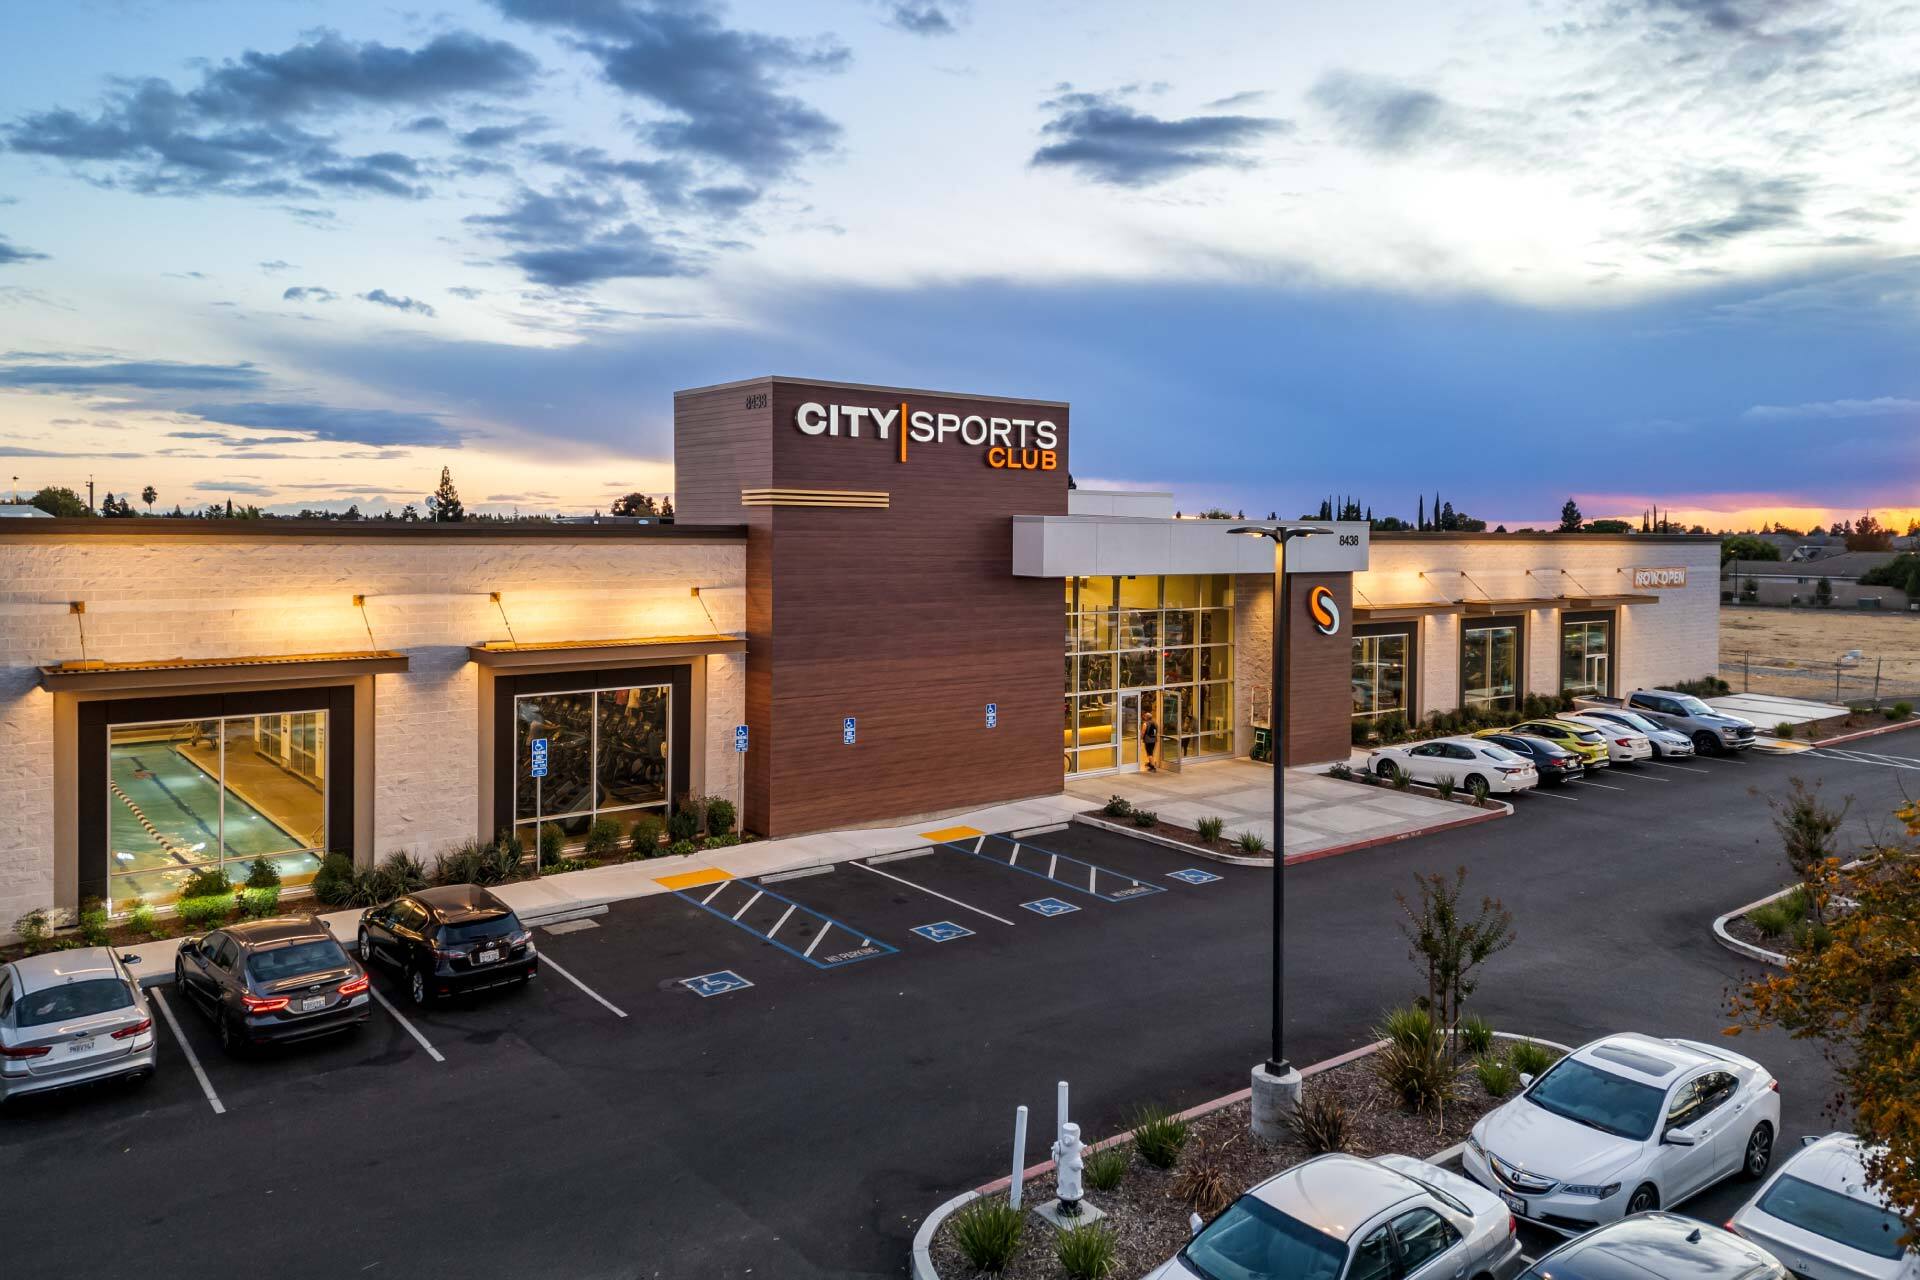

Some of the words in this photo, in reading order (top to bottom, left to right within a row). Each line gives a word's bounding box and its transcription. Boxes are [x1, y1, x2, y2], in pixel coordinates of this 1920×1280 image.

[797, 402, 899, 439] CITY
[910, 411, 1058, 449] SPORTS
[988, 447, 1057, 470] CLUB
[1340, 535, 1359, 546] 8438
[1635, 571, 1660, 585] NOW
[1660, 571, 1685, 585] OPEN
[824, 955, 843, 963] NO
[839, 947, 880, 960] PARKING
